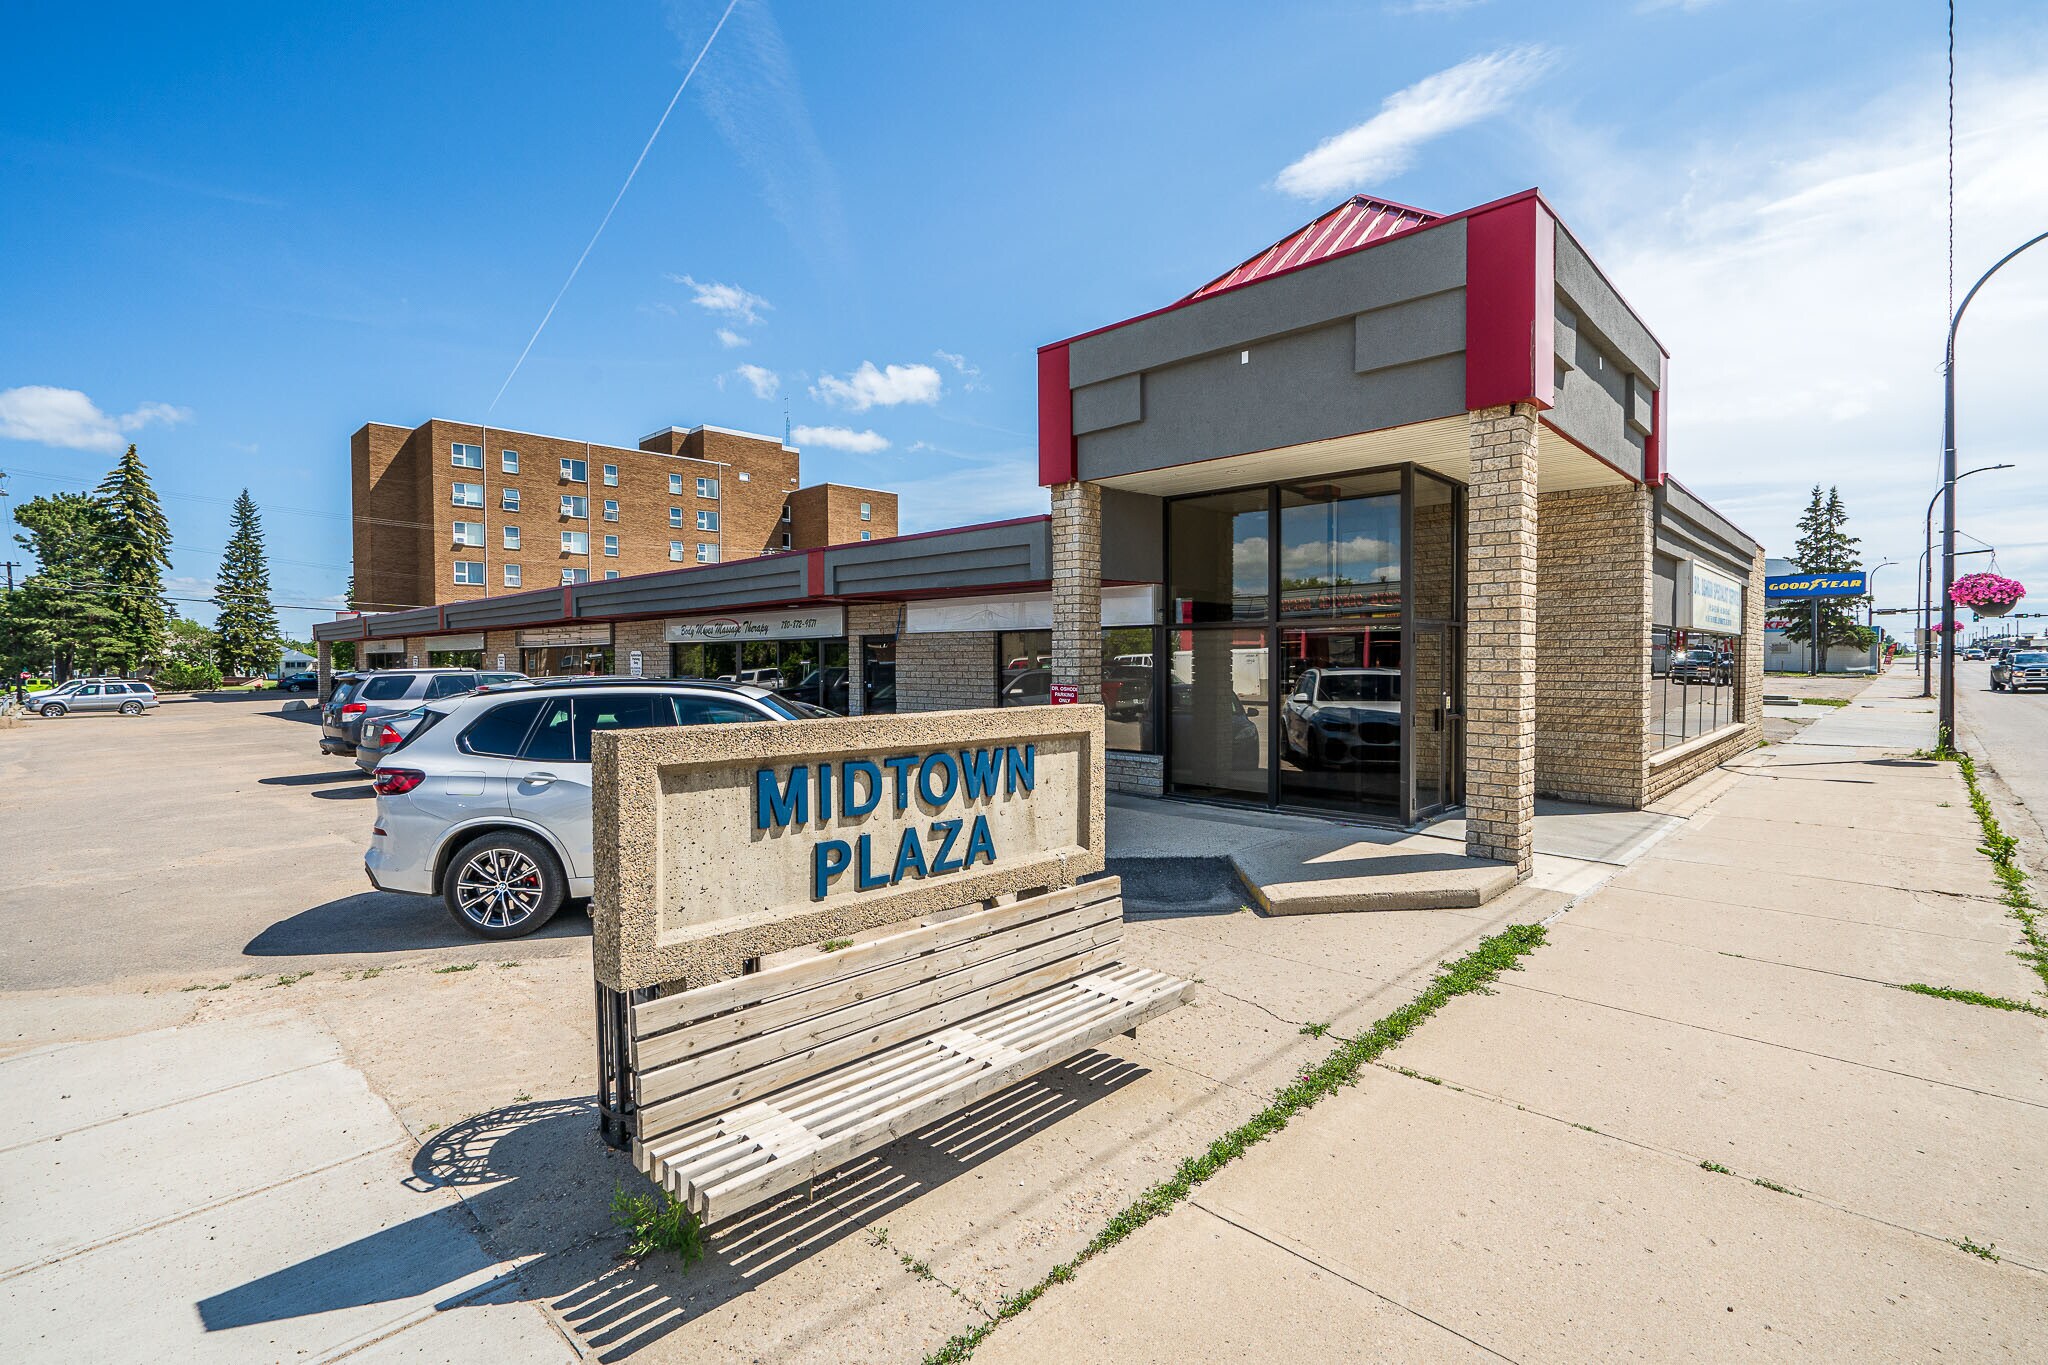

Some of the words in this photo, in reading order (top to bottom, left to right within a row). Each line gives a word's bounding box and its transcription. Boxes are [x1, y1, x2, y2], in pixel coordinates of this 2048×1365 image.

[681, 624, 694, 638] Body
[714, 622, 741, 637] Massage
[743, 620, 769, 636] Therapy
[756, 744, 1036, 830] MIDTOWN
[814, 814, 997, 900] PLAZA
